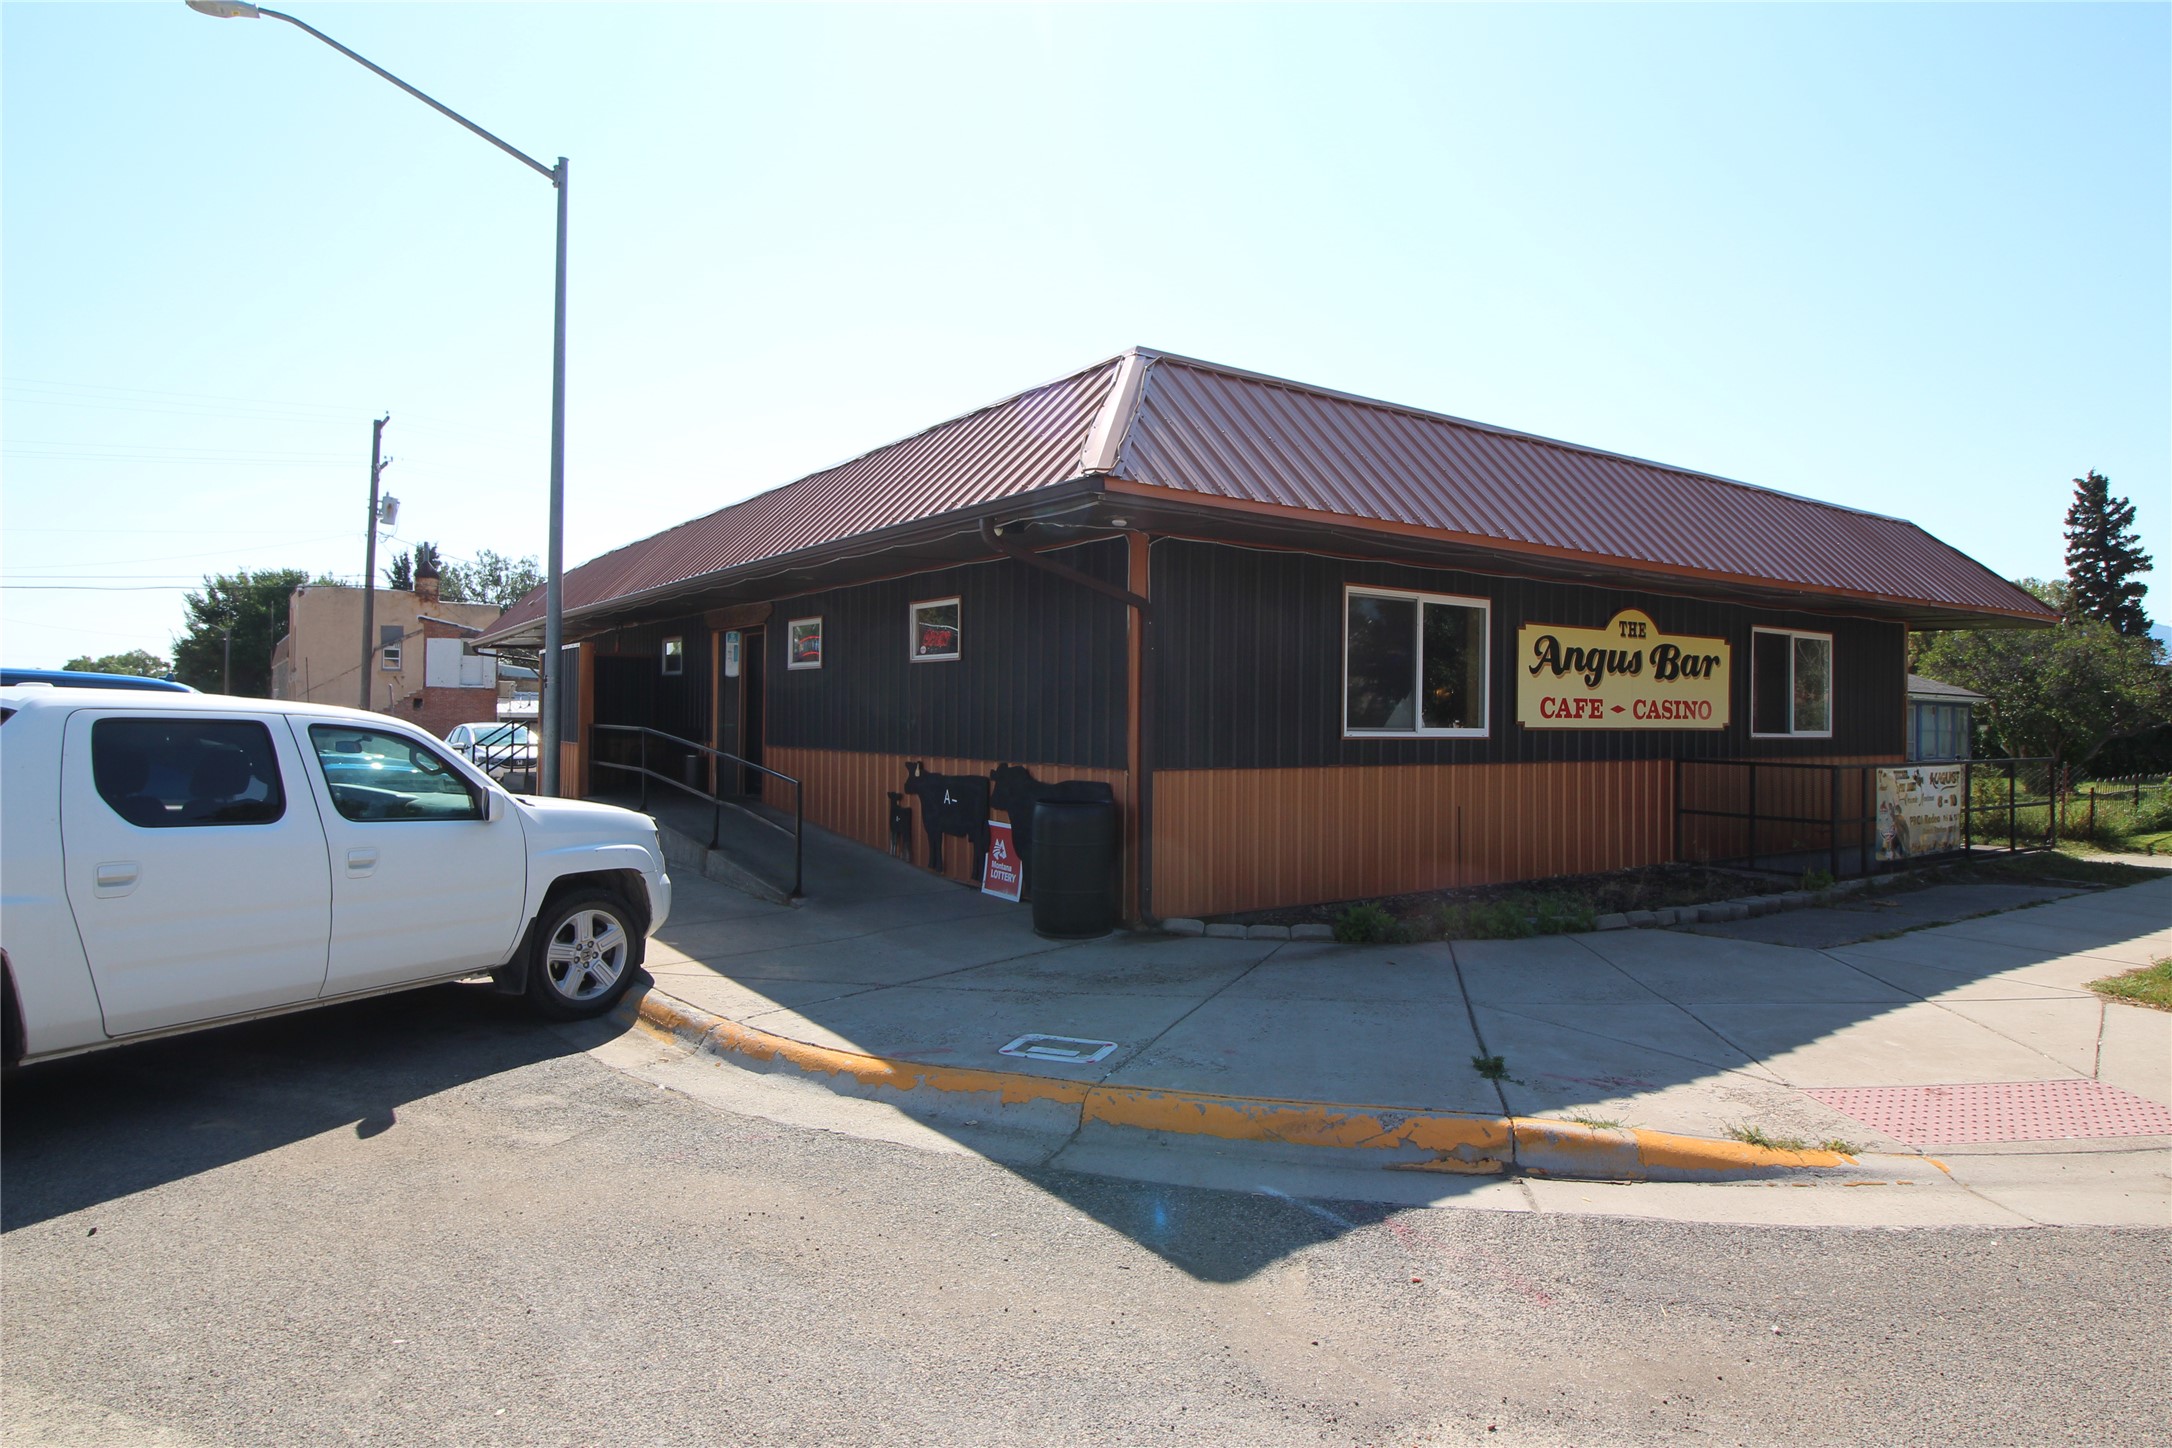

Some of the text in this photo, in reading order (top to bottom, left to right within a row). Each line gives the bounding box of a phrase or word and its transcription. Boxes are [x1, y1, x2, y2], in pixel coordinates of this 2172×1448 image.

[1618, 620, 1647, 638] THE
[1528, 634, 1721, 689] Angus Bar
[1539, 696, 1713, 721] CAFE CASINO
[1929, 771, 1960, 788] AUGUST
[991, 860, 1013, 872] Montana
[990, 869, 1016, 883] LOTTERY
